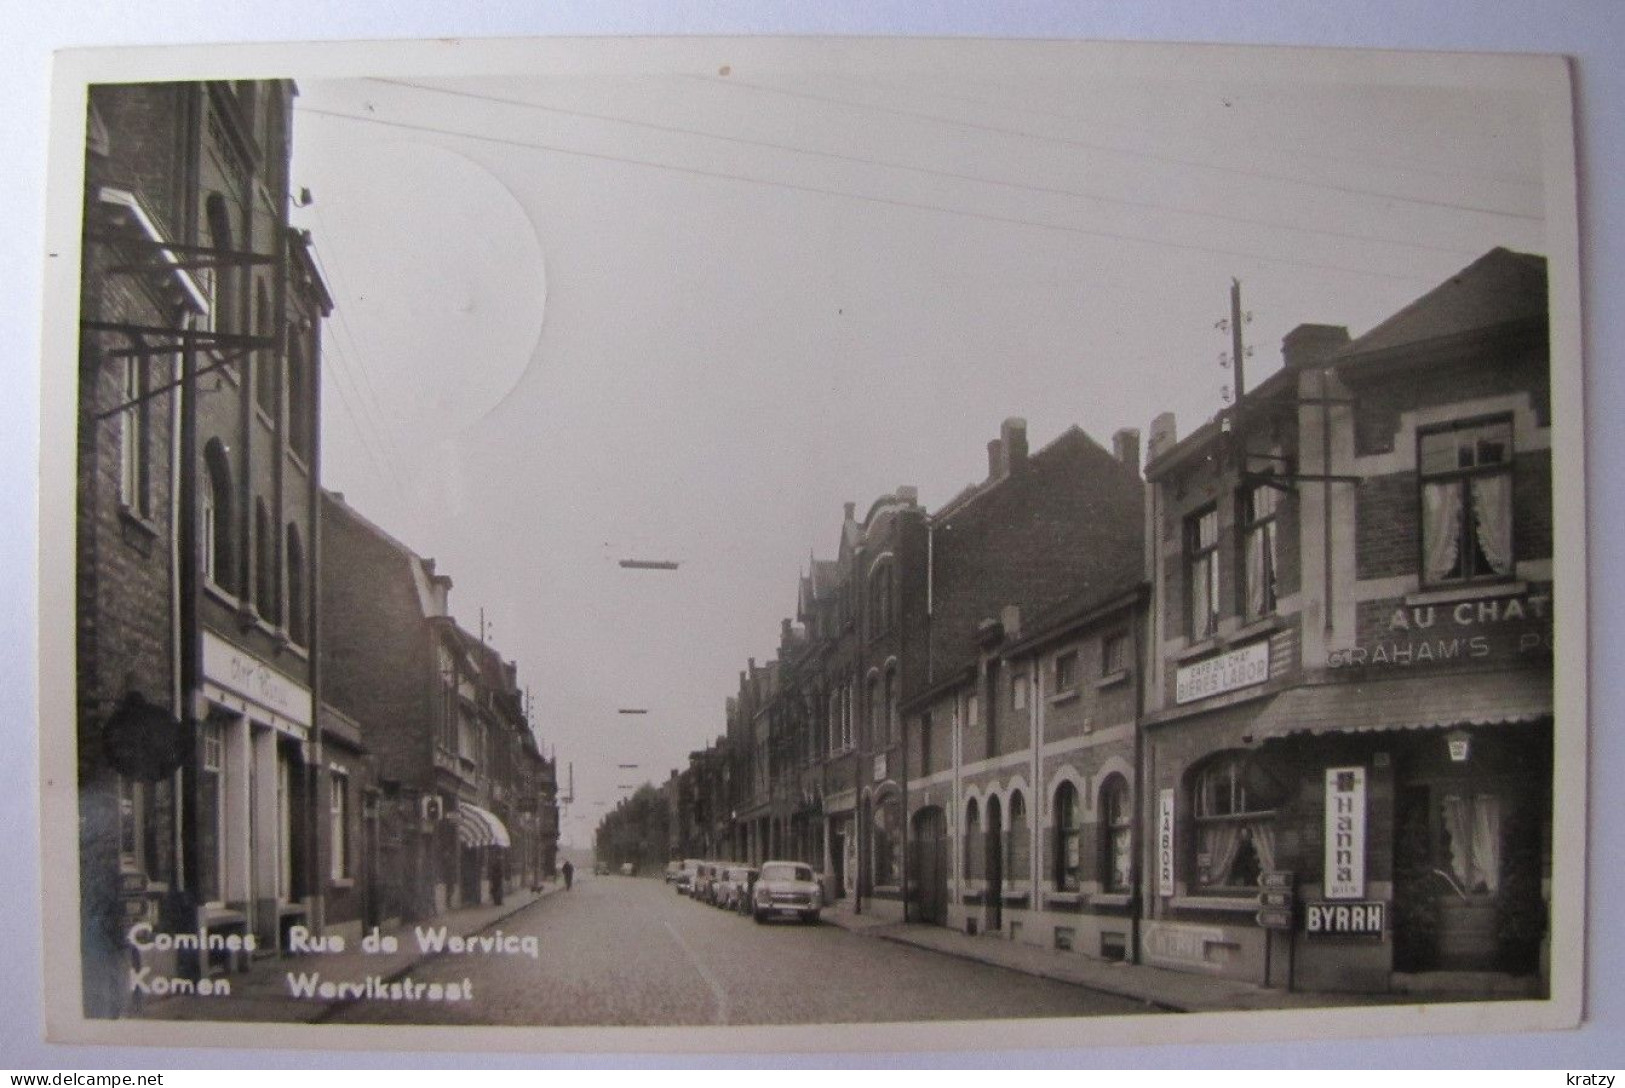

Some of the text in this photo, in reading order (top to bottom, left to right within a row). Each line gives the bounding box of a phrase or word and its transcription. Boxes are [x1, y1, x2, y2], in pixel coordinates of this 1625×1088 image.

[1390, 597, 1548, 629] AU CHAT
[1327, 636, 1489, 667] GRAHAM'S
[1160, 800, 1171, 881] LABOR
[1307, 905, 1382, 932] BYRRH
